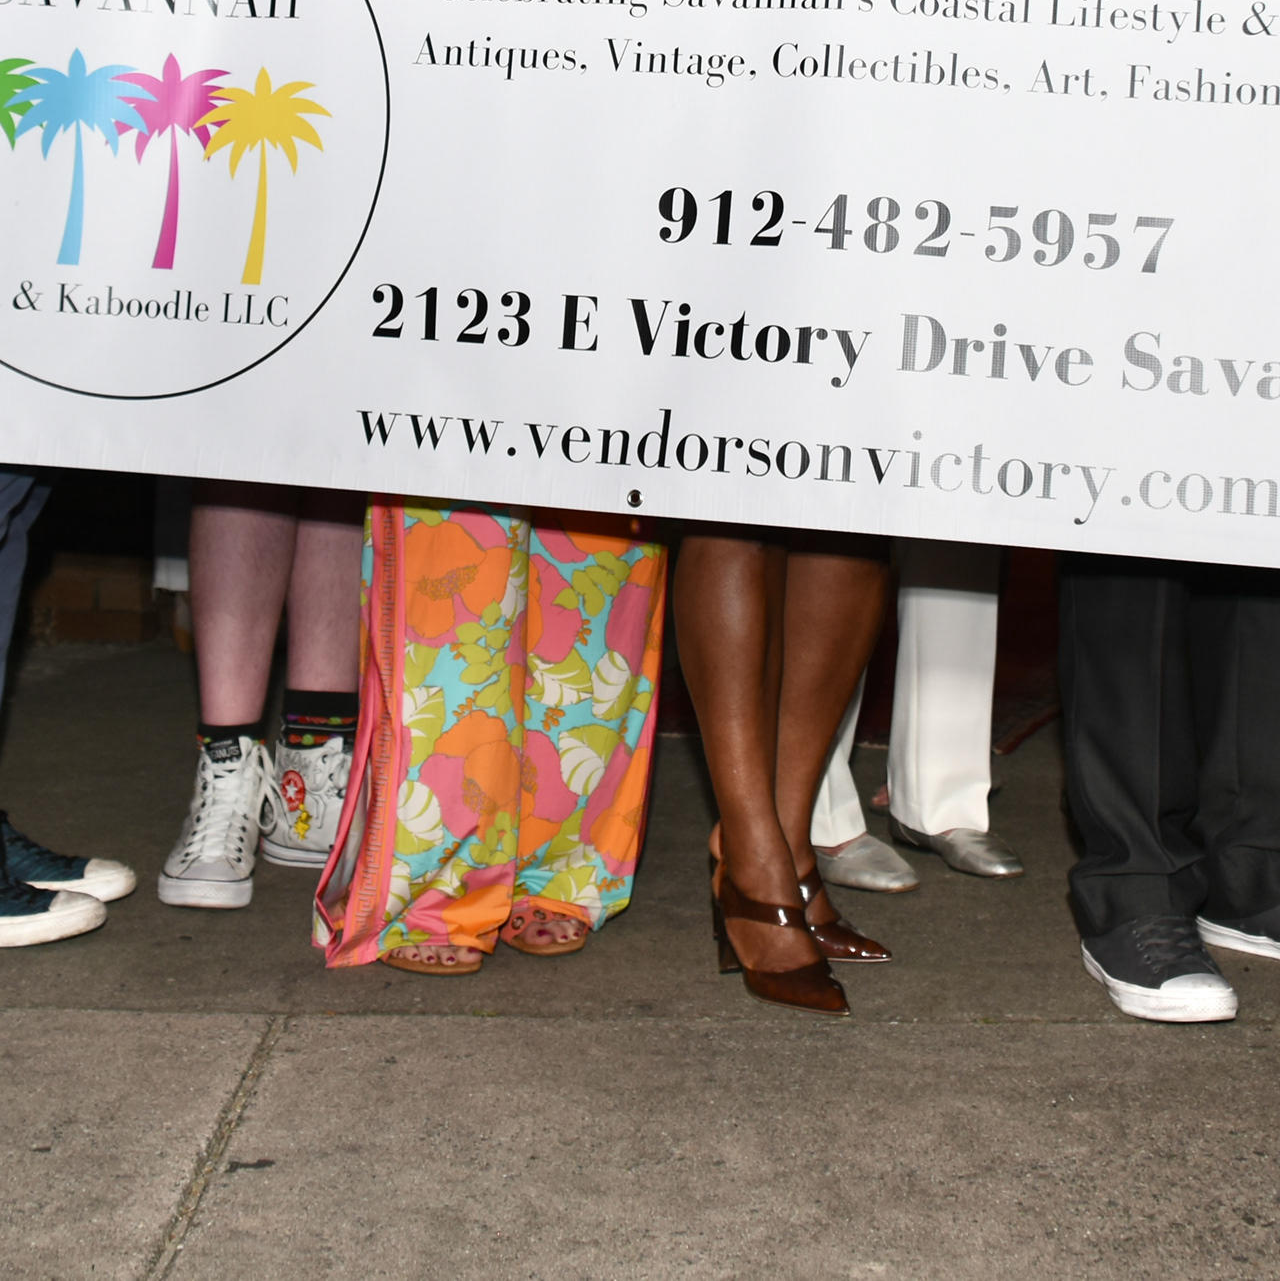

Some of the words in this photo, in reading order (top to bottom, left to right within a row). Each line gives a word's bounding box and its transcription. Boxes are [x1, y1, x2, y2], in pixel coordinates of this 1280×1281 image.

[1242, 2, 1278, 37] &
[412, 32, 588, 80] Antiques,
[604, 38, 756, 86] Vintage,
[773, 43, 1010, 94] Collectibles,
[1028, 59, 1107, 101] Art,
[658, 186, 1175, 274] 912-482-5957
[12, 280, 43, 312] &
[56, 282, 209, 323] Kaboodle
[220, 292, 289, 328] LLC
[371, 283, 532, 348] 2123
[558, 294, 598, 352] E
[627, 297, 873, 389] Victory
[897, 313, 1094, 387] Drive
